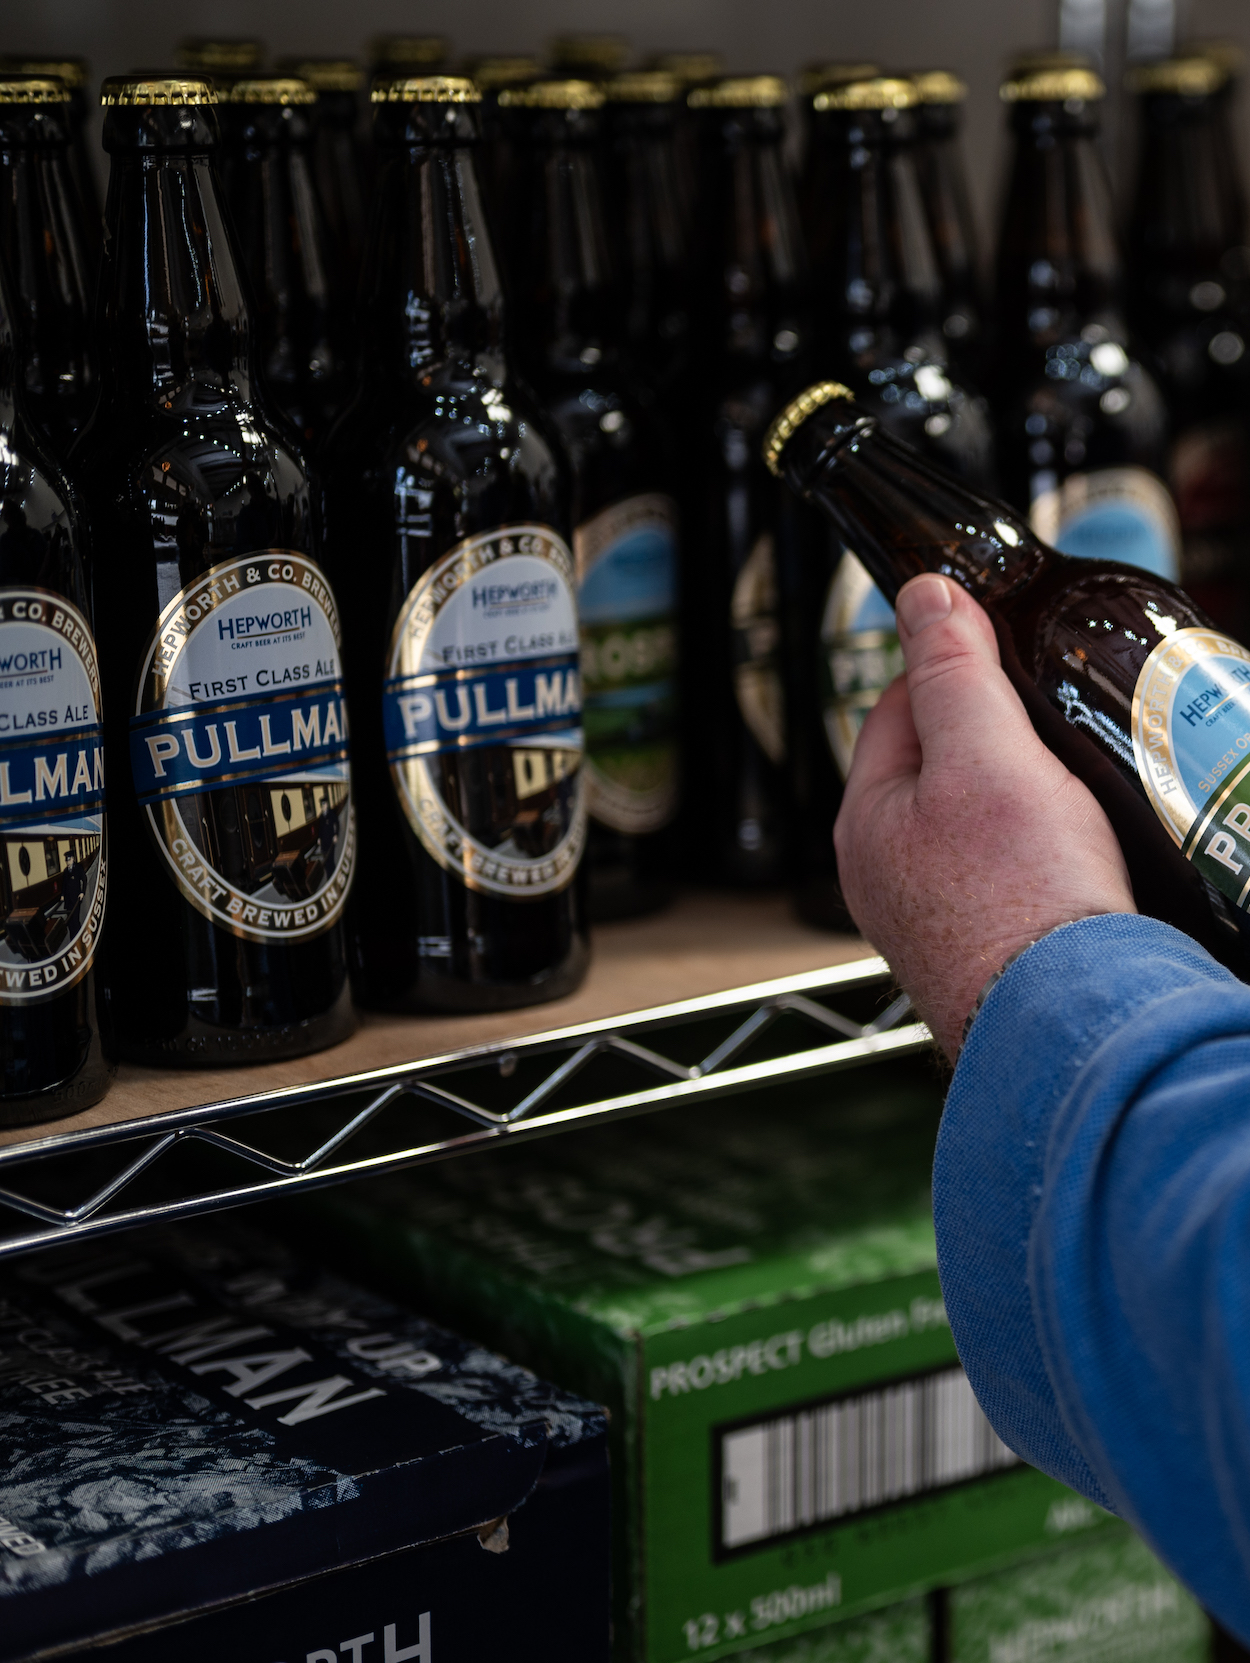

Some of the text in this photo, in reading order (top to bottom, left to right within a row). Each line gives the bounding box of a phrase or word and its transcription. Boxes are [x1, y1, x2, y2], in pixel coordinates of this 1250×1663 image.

[12, 601, 99, 693] CO. BREWERS
[151, 574, 241, 678] HEPWORTH
[246, 567, 261, 583] &
[268, 564, 297, 583] CO.
[218, 605, 312, 640] HEPWORTH
[231, 631, 306, 650] CRAFT BEER AT ITS BEST
[0, 647, 62, 673] WORTH
[442, 641, 499, 664] FIRST
[505, 632, 554, 655] CLASS
[0, 674, 54, 689] EER AT ITS BEST
[188, 658, 335, 700] FIRST CLASS ALE
[397, 668, 582, 740] PULLMA
[0, 704, 88, 732] CLASS ALE
[144, 698, 350, 778] PULLMAN
[1148, 671, 1178, 795] HEPWORTH
[1168, 656, 1184, 668] &
[1205, 711, 1223, 727] CRAFT
[0, 746, 105, 806] LMAN
[1198, 748, 1239, 793] SUSSEX
[171, 838, 227, 902] CRAFT
[226, 897, 318, 928] BREWED
[321, 886, 338, 912] IN
[0, 860, 107, 988] WED IN SUSSEX
[15, 1250, 387, 1427] ULLMAN
[345, 1332, 444, 1375] UP
[650, 1329, 804, 1401] PROSPECT
[807, 1314, 911, 1360] Gluten
[8, 1370, 93, 1405] REE
[682, 1570, 842, 1651] 12 x 500ml
